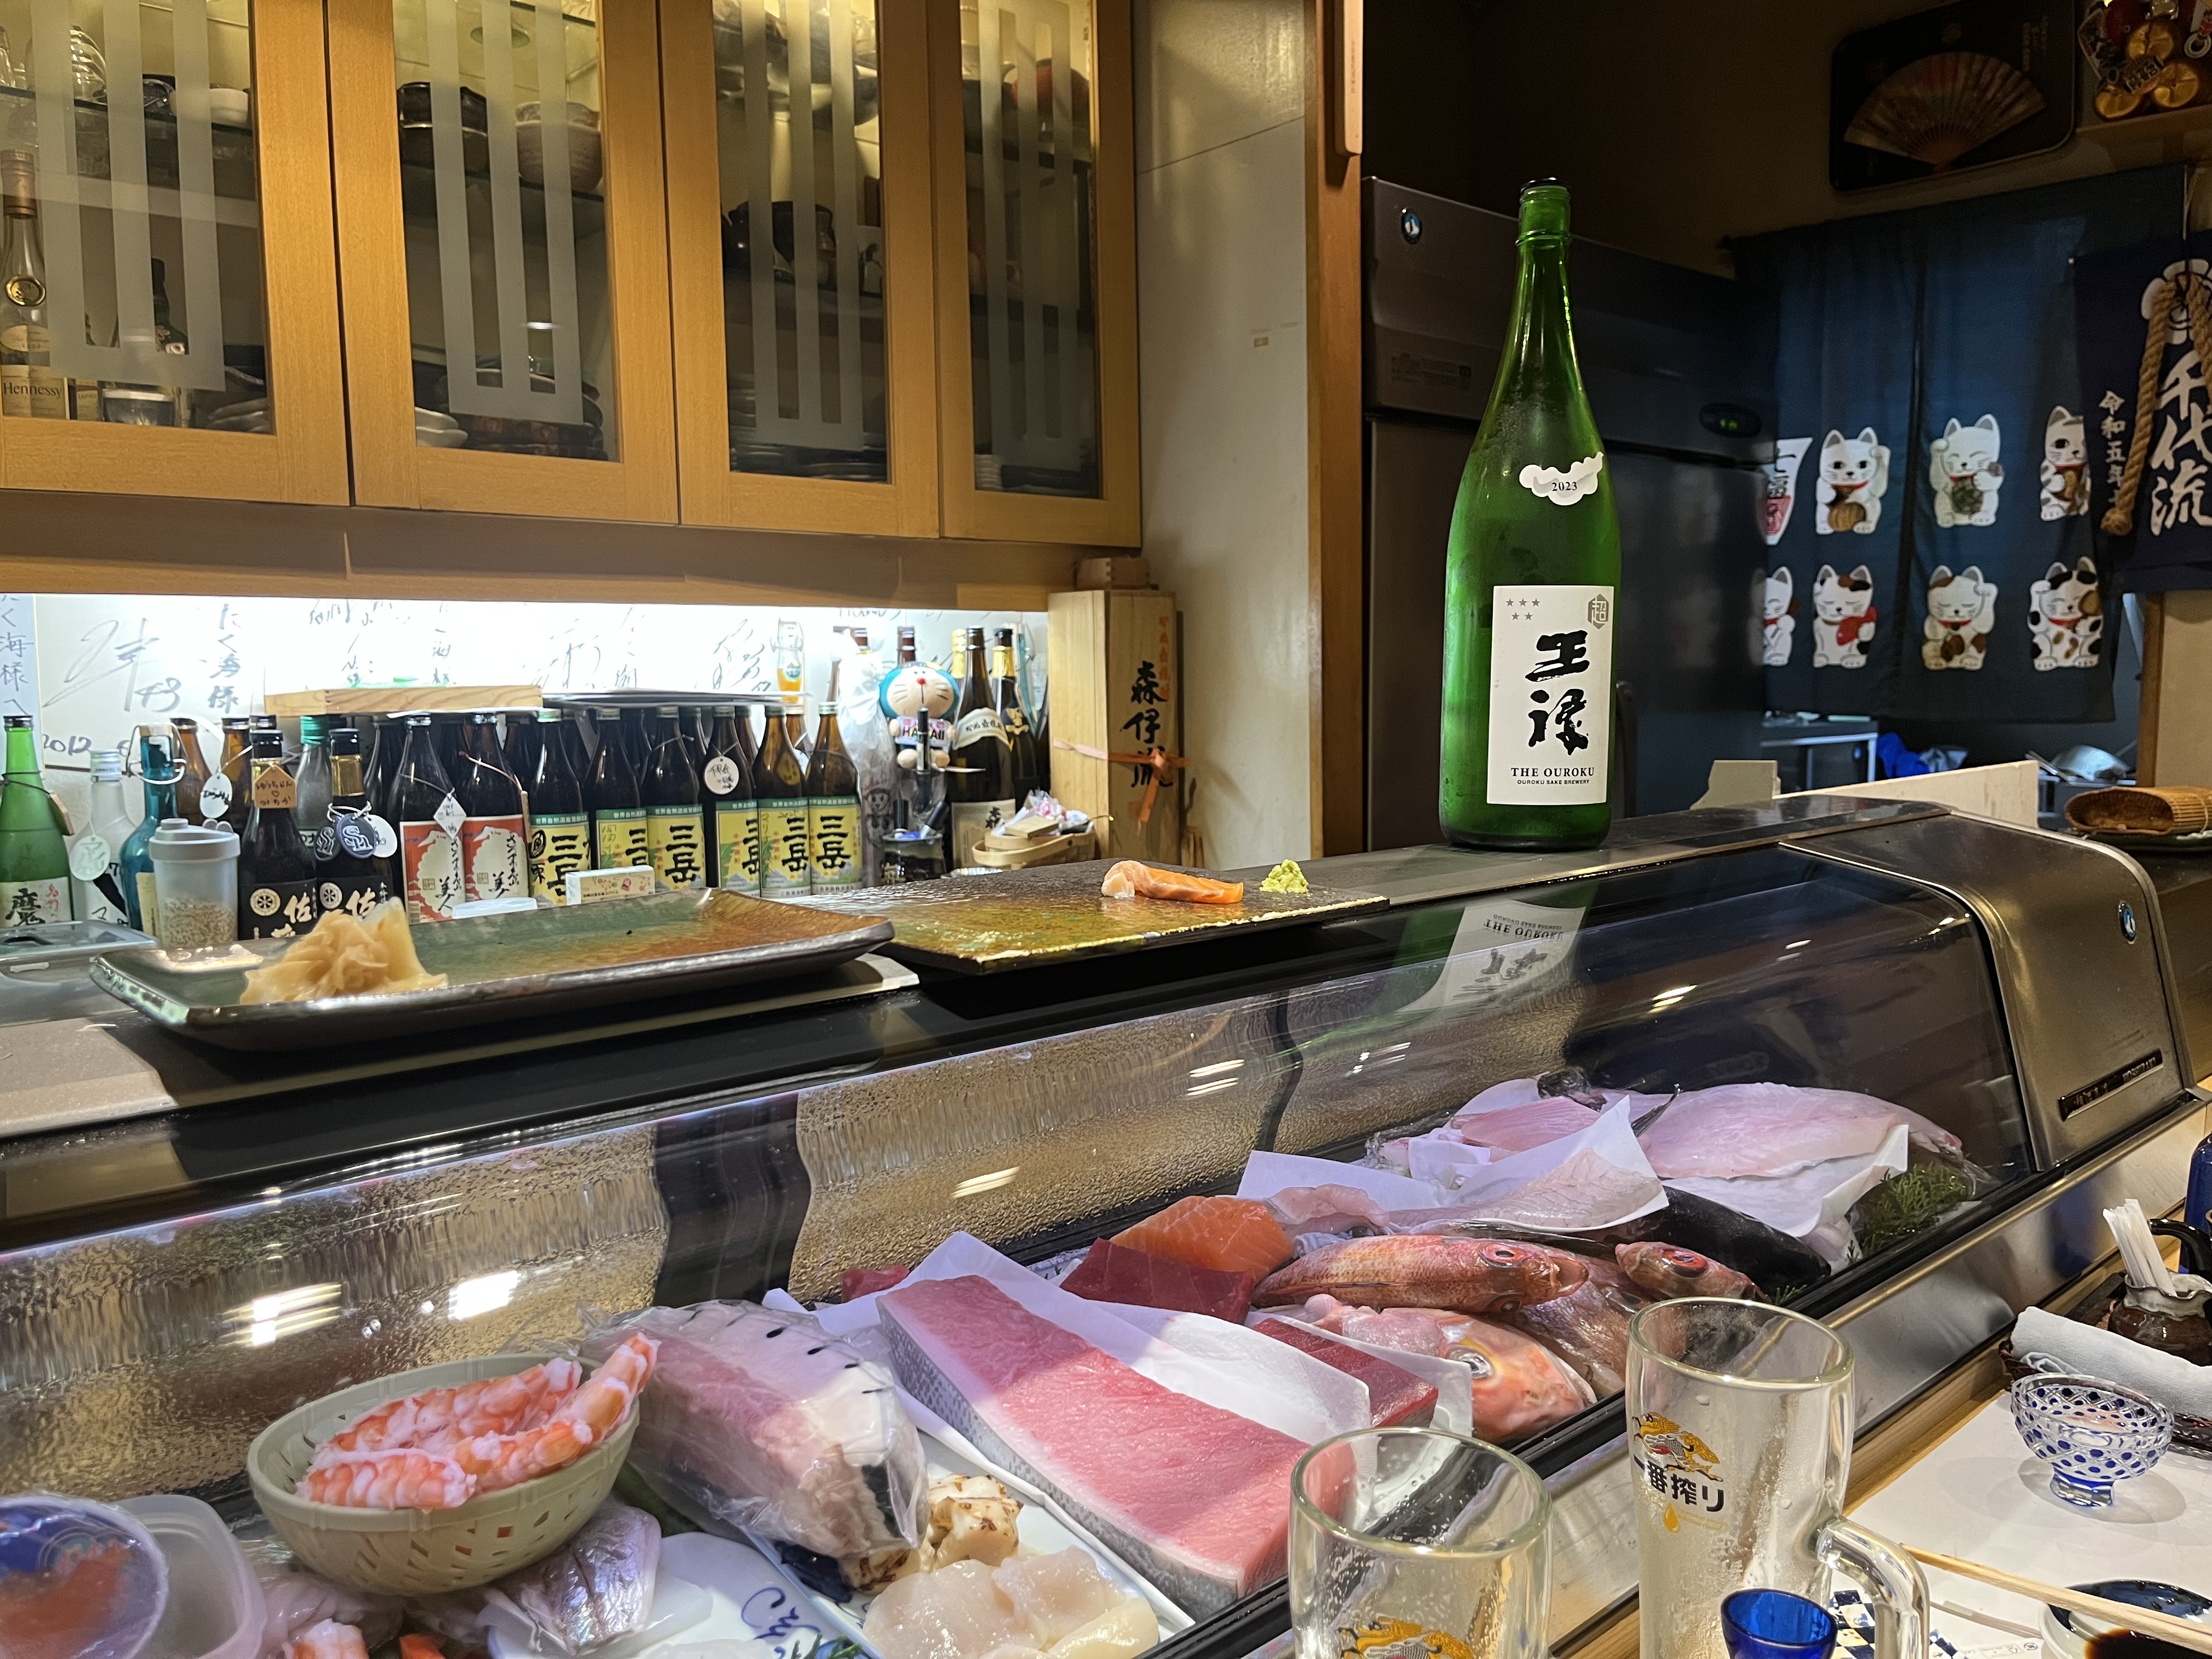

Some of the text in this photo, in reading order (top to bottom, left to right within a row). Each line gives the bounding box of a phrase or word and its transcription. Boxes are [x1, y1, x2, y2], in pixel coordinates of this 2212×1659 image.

[3, 382, 60, 398] Hennessy
[2099, 390, 2126, 503] 令和五年
[1551, 482, 1578, 492] 2023
[1591, 597, 1608, 624] 超
[903, 726, 945, 741] HAAII
[1511, 767, 1595, 777] THE OUROKU
[664, 825, 701, 884] 三岳
[782, 816, 809, 872] 三岳
[816, 815, 851, 868] 三岳
[5, 888, 46, 927] 魔
[1633, 1454, 1724, 1512] 一番搾り
